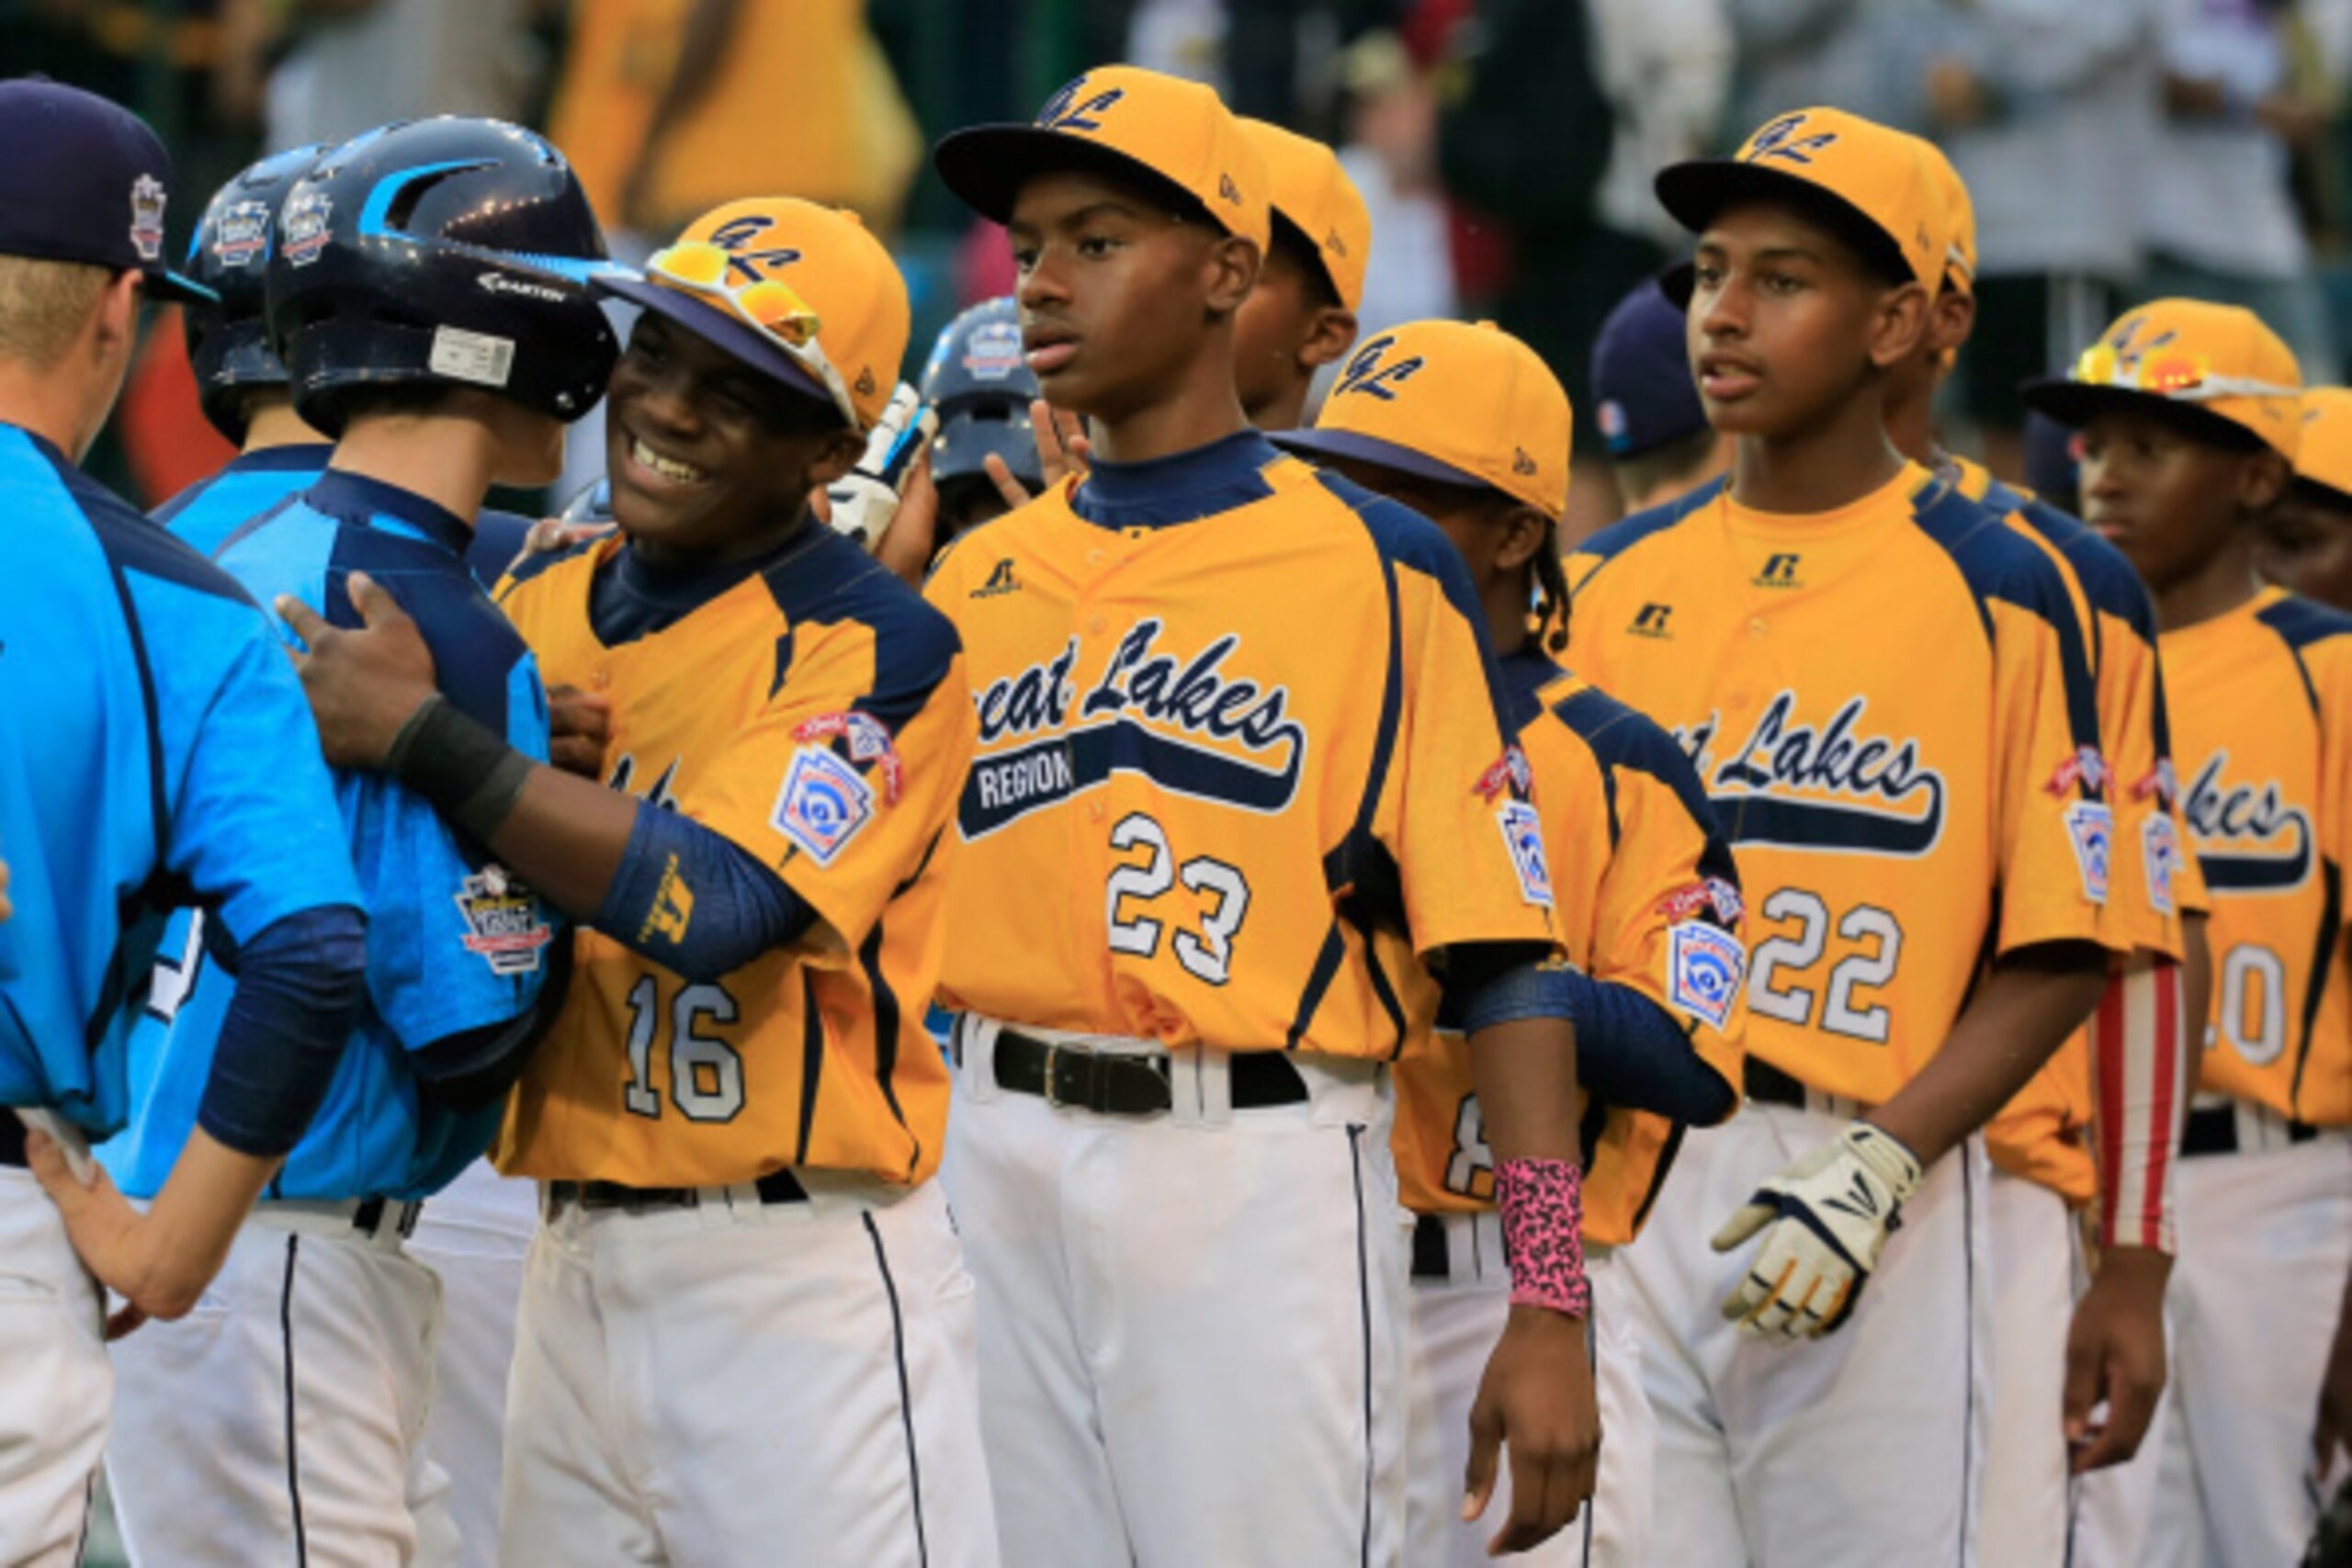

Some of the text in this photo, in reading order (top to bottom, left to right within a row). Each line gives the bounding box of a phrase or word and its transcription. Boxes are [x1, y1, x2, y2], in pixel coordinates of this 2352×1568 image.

[969, 615, 1294, 751] eat Lakes
[1714, 687, 1935, 802] Lakes
[1104, 809, 1252, 987] 23
[1746, 886, 1905, 1045] 22
[624, 973, 747, 1124] 16
[2203, 941, 2285, 1066] 0
